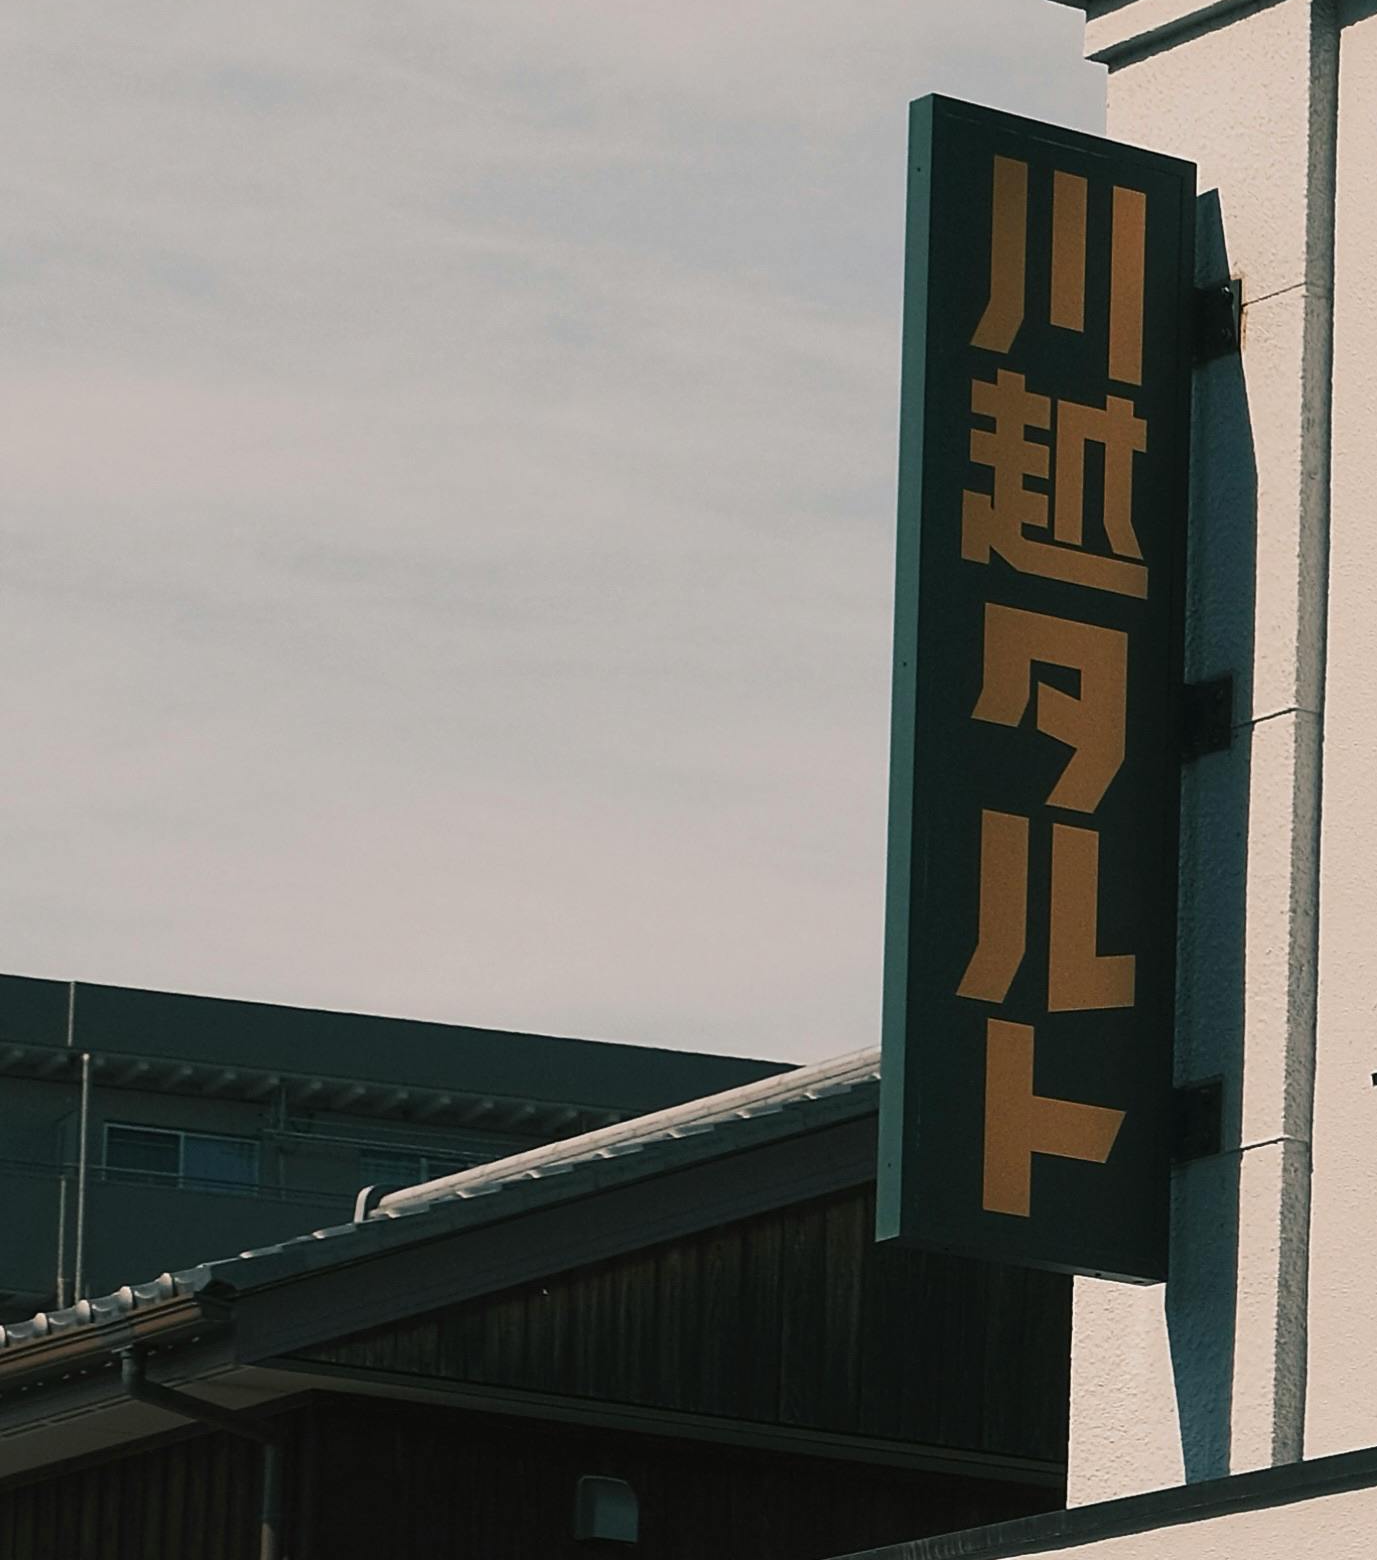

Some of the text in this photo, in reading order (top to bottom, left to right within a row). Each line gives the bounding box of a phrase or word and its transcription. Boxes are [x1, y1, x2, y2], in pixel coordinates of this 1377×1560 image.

[955, 156, 1148, 1217] 川越タルト
